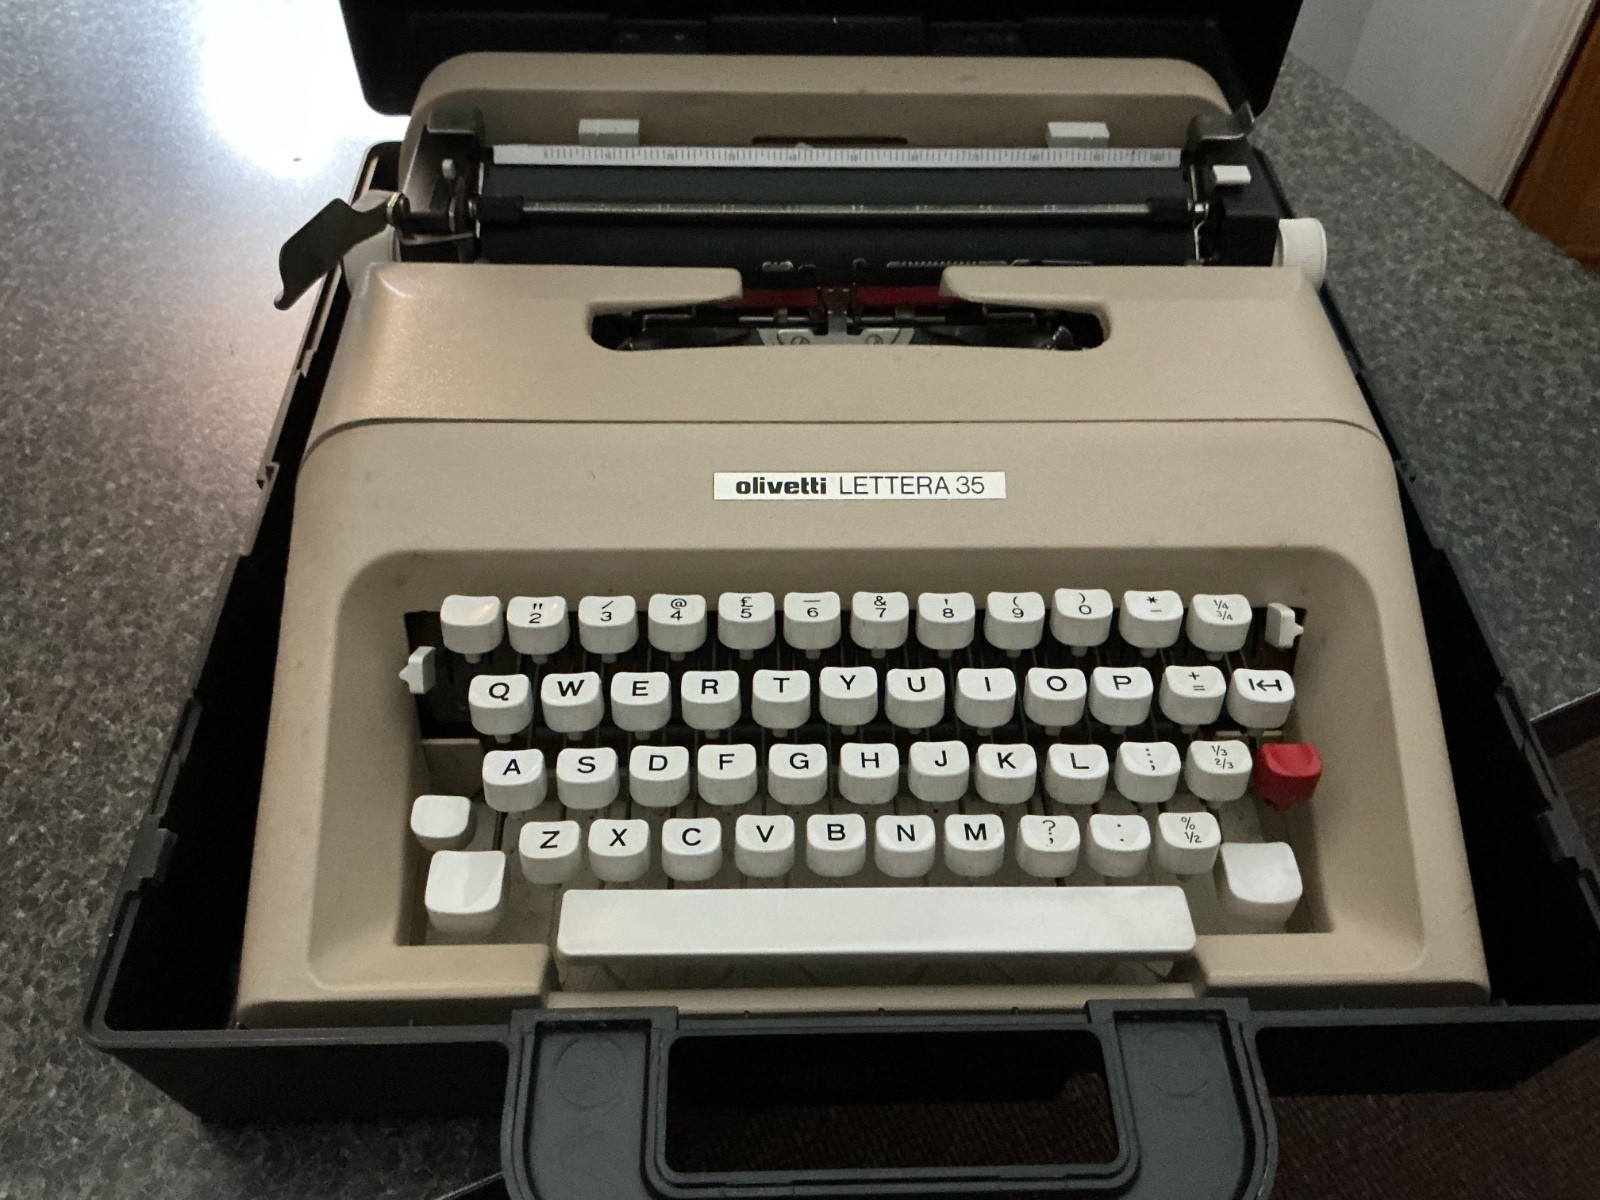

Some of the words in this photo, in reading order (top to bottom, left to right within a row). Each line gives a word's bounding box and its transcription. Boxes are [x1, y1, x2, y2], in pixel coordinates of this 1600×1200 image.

[735, 477, 827, 495] olivetti
[839, 476, 950, 495] LETTERA
[956, 476, 985, 494] 35
[670, 598, 688, 610] @
[740, 596, 753, 608] £
[873, 595, 887, 607] &
[528, 612, 542, 624] 2
[600, 611, 613, 622] 3
[669, 609, 683, 621] 4
[740, 607, 753, 619] 5
[806, 607, 819, 618] 6
[875, 607, 887, 618] 7
[942, 607, 955, 619] 8
[1011, 607, 1025, 619] 9
[556, 679, 585, 697] W
[631, 680, 650, 697] E
[701, 678, 719, 695] R
[772, 677, 791, 694] T
[839, 674, 856, 691] Y
[906, 676, 926, 693] U
[984, 676, 992, 692] I
[1046, 675, 1068, 692] O
[1112, 674, 1132, 691] P
[488, 682, 510, 702] Q
[502, 758, 521, 776] A
[576, 755, 596, 774] S
[648, 754, 669, 772] D
[719, 753, 735, 771] F
[789, 752, 810, 770] G
[860, 751, 880, 769] H
[934, 750, 948, 767] J
[996, 751, 1017, 770] K
[1070, 752, 1090, 770] L
[755, 824, 775, 843] V
[826, 823, 846, 842] B
[896, 824, 916, 842] N
[963, 822, 987, 841] M
[1042, 819, 1056, 836] ?
[539, 830, 561, 850] Z
[608, 828, 628, 847] X
[681, 827, 702, 847] C
